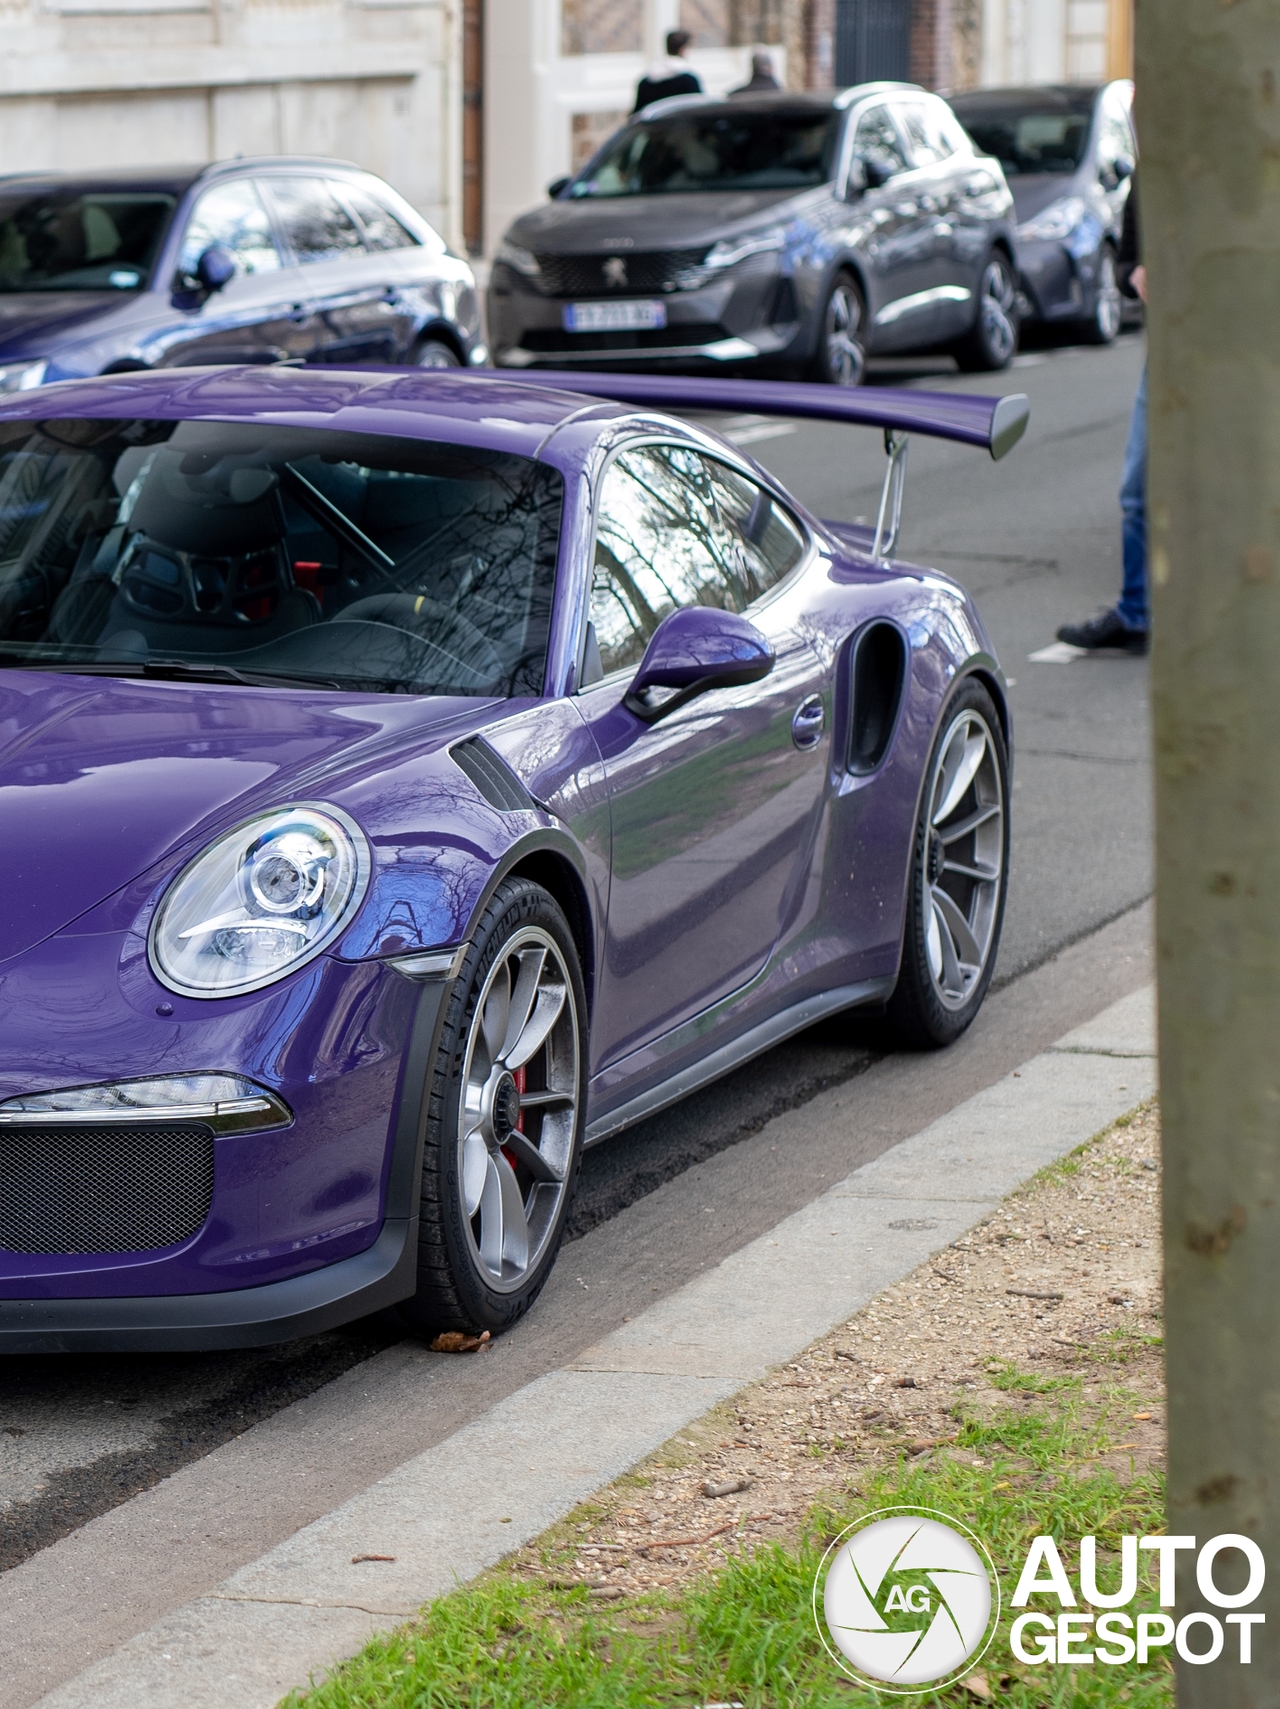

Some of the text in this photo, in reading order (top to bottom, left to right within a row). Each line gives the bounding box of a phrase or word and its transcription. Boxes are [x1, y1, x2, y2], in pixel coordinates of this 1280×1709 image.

[475, 901, 521, 991] MICHELIN
[447, 1170, 457, 1187] 2
[449, 1189, 459, 1224] Cup
[452, 1227, 469, 1272] Sport
